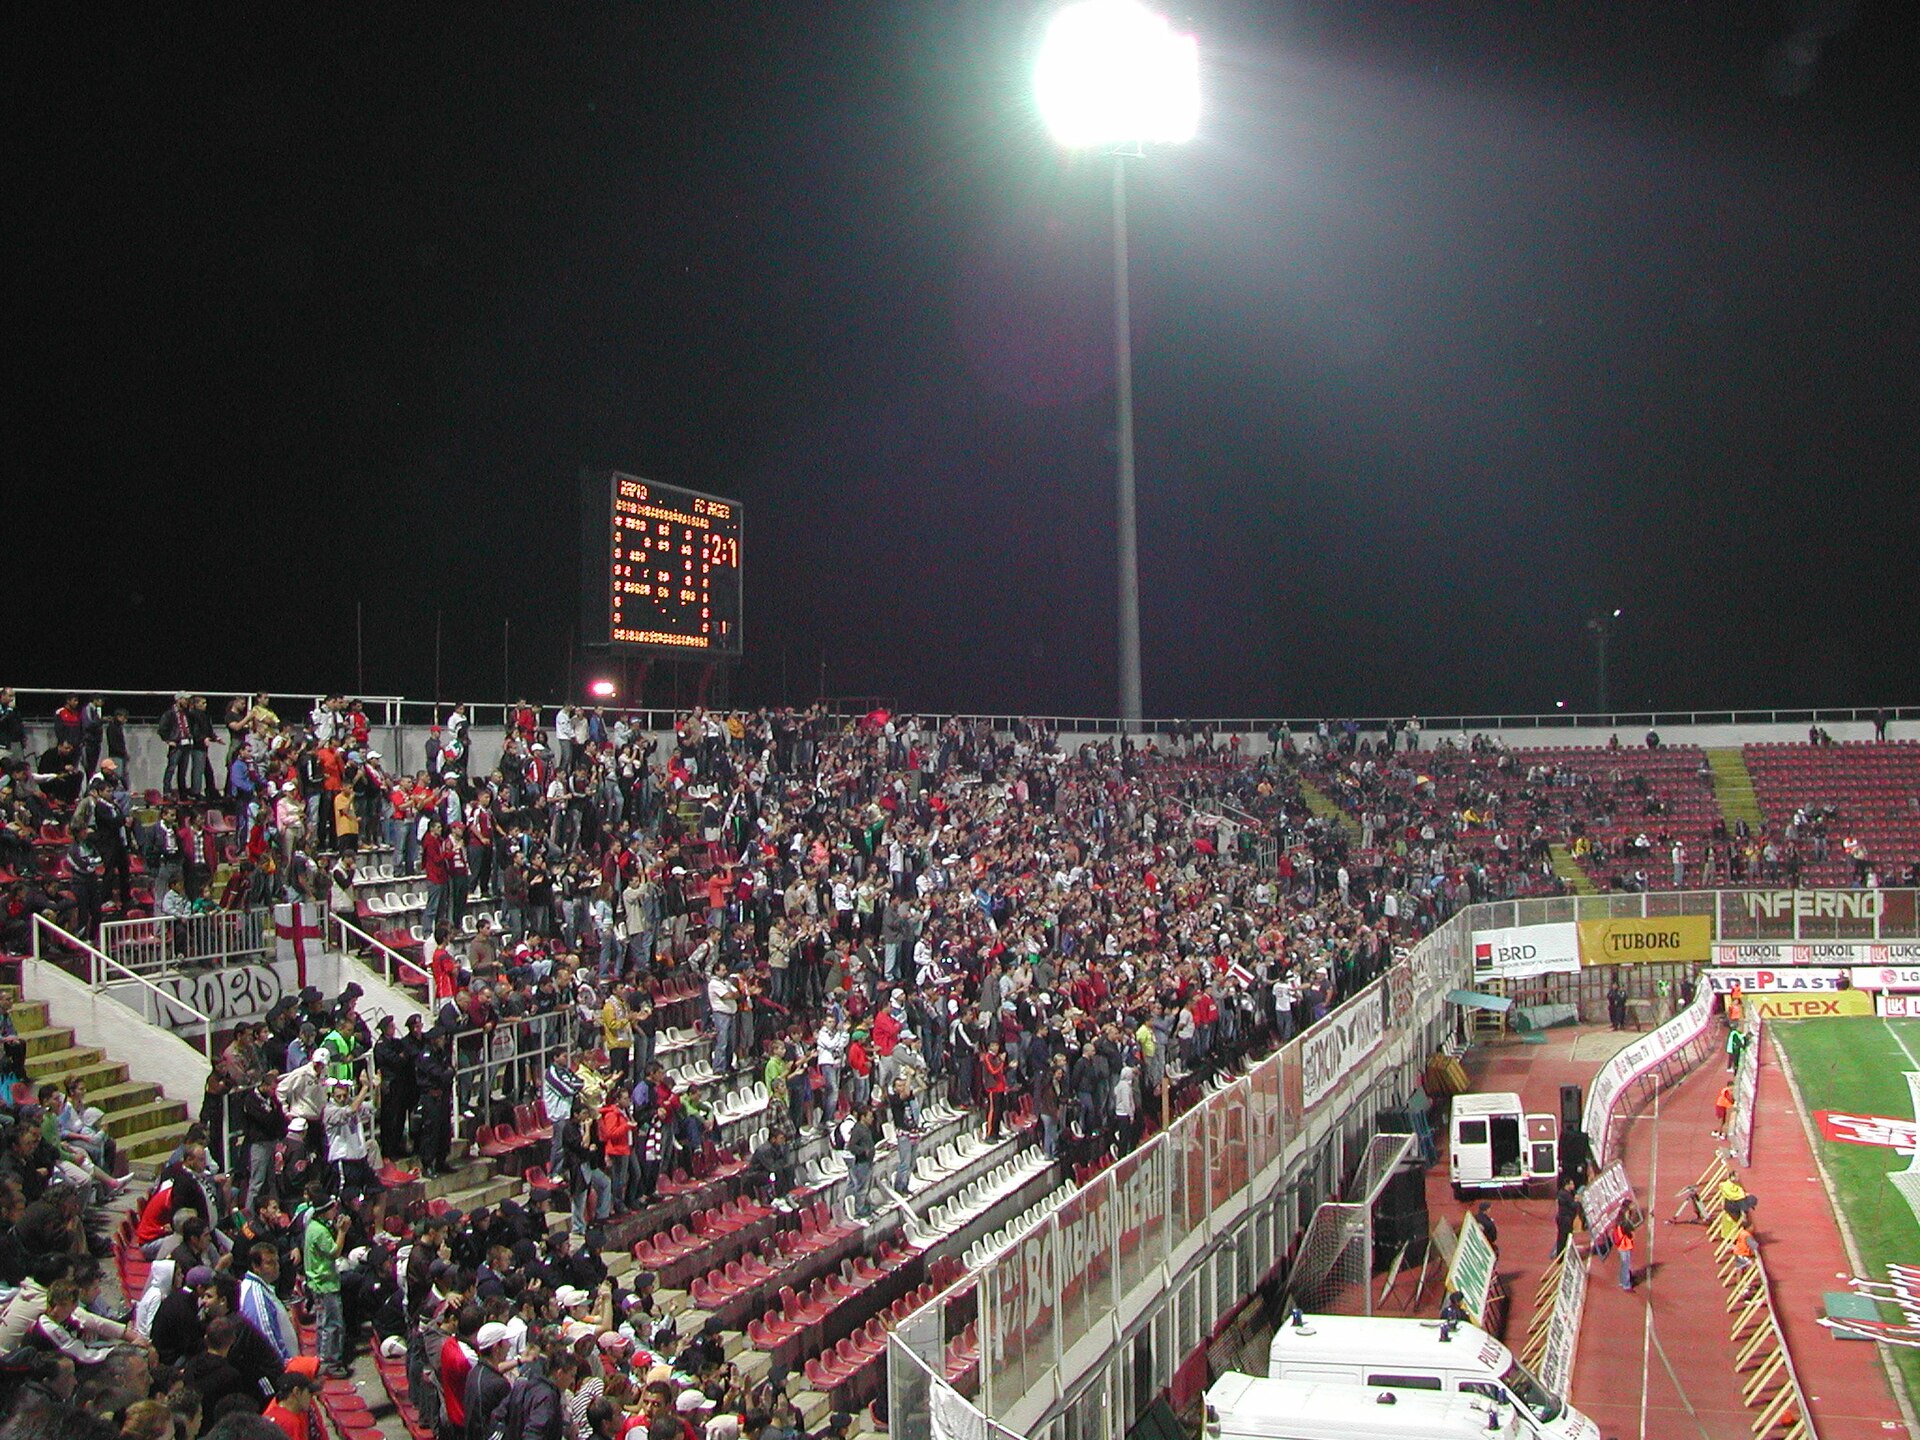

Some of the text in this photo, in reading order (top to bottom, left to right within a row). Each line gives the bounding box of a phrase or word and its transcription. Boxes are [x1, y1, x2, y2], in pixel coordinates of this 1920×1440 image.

[1611, 932, 1680, 950] TUBORG
[1498, 944, 1537, 962] BRD
[1738, 945, 1781, 957] LUKOIL
[1813, 945, 1854, 957] LUKOIL
[1901, 971, 1920, 982] LG
[155, 961, 283, 1028] NORD
